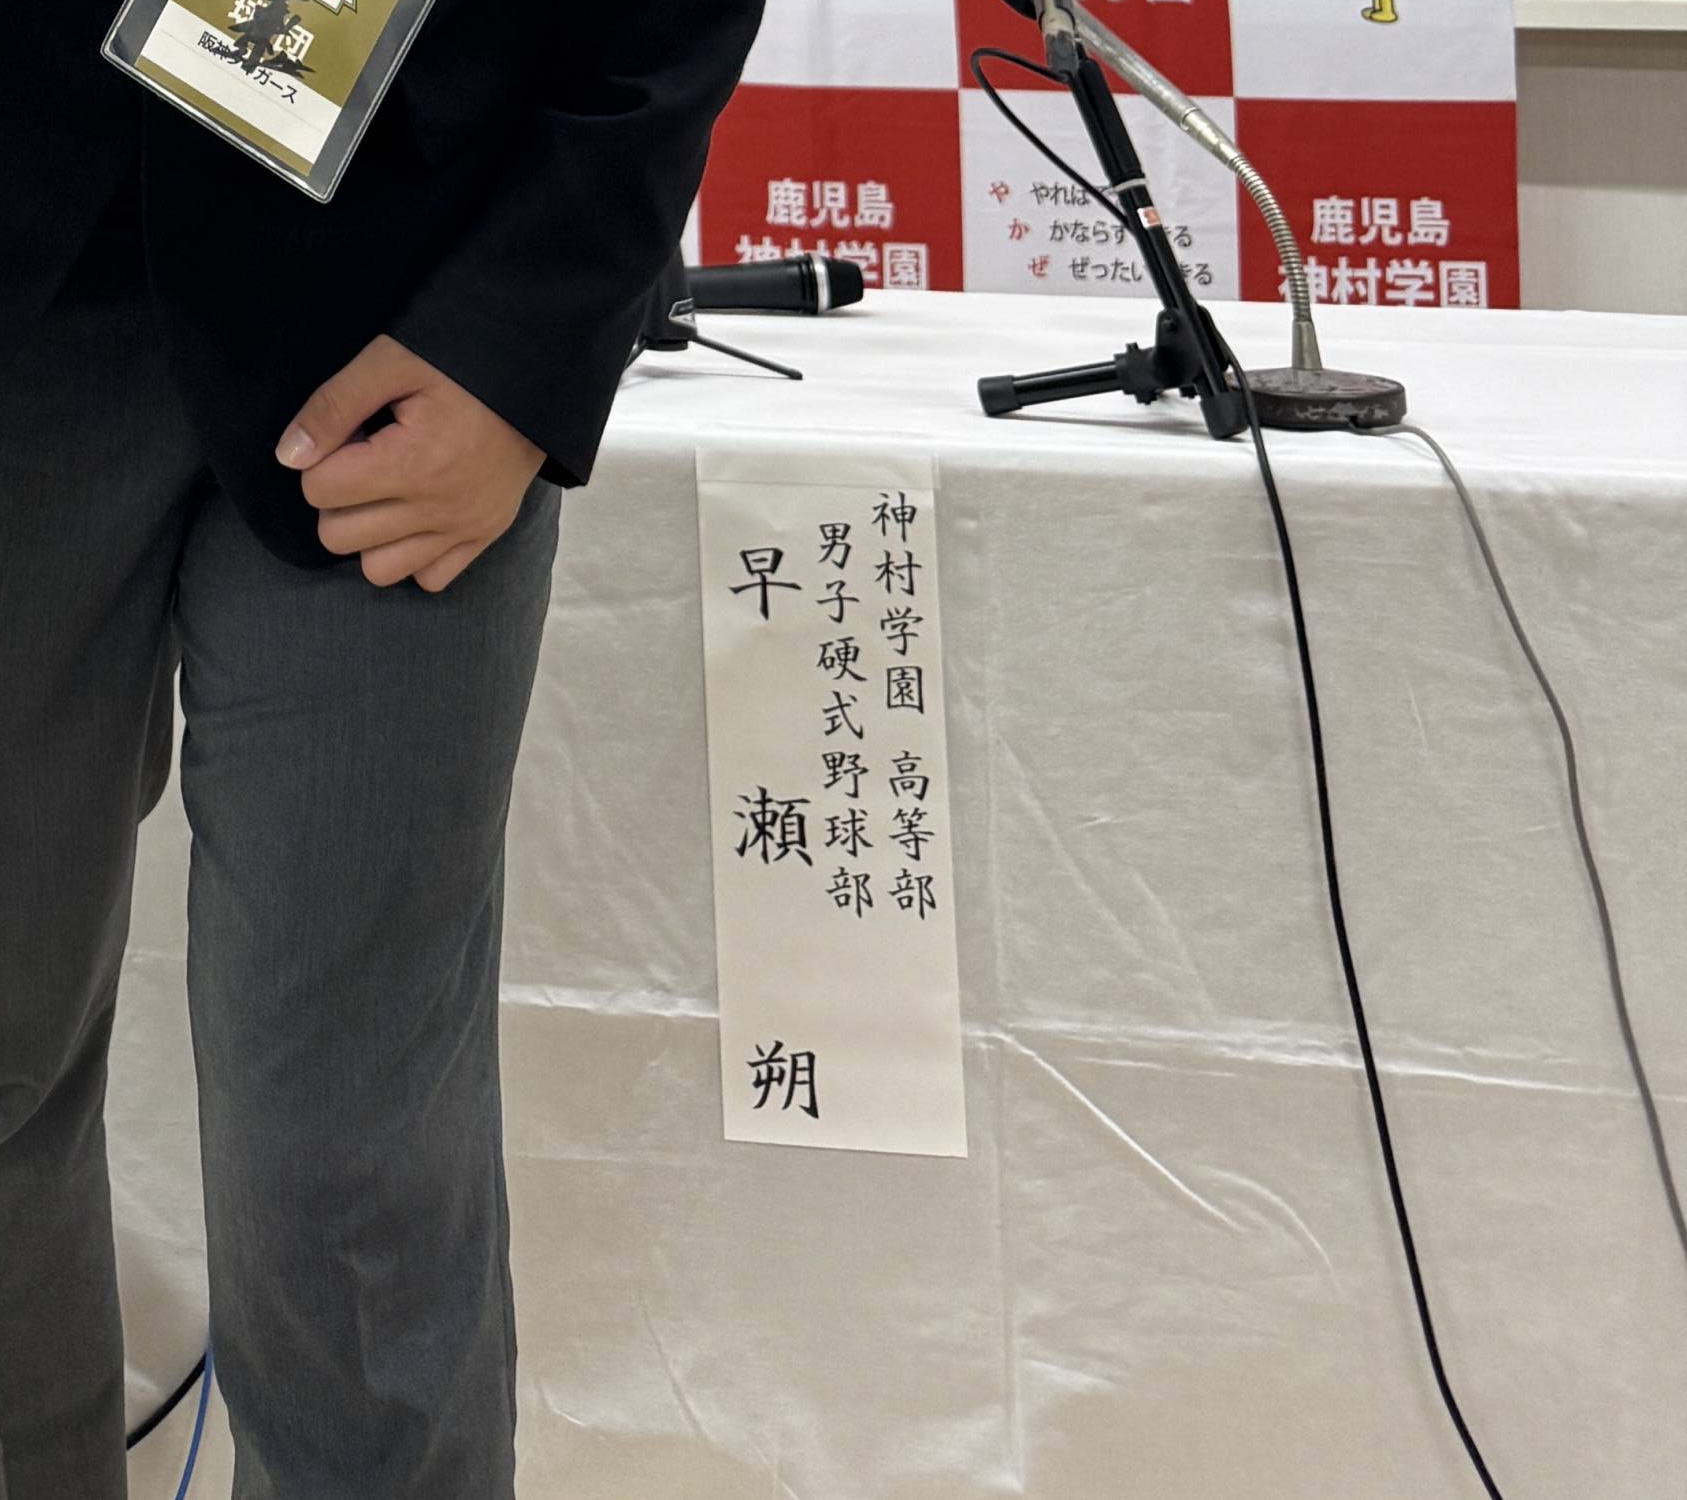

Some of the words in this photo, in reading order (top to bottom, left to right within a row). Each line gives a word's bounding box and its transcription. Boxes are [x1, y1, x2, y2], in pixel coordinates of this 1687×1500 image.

[765, 178, 894, 230] 鹿児島
[989, 181, 1009, 203] や
[1008, 217, 1030, 240] か
[1311, 195, 1450, 247] 鹿児島
[1028, 256, 1049, 279] ぜ
[871, 491, 925, 715] 神村学園
[815, 521, 875, 919] 男子硬式野球部
[728, 546, 820, 1119] 早瀬朔
[887, 750, 937, 919] 高等部
